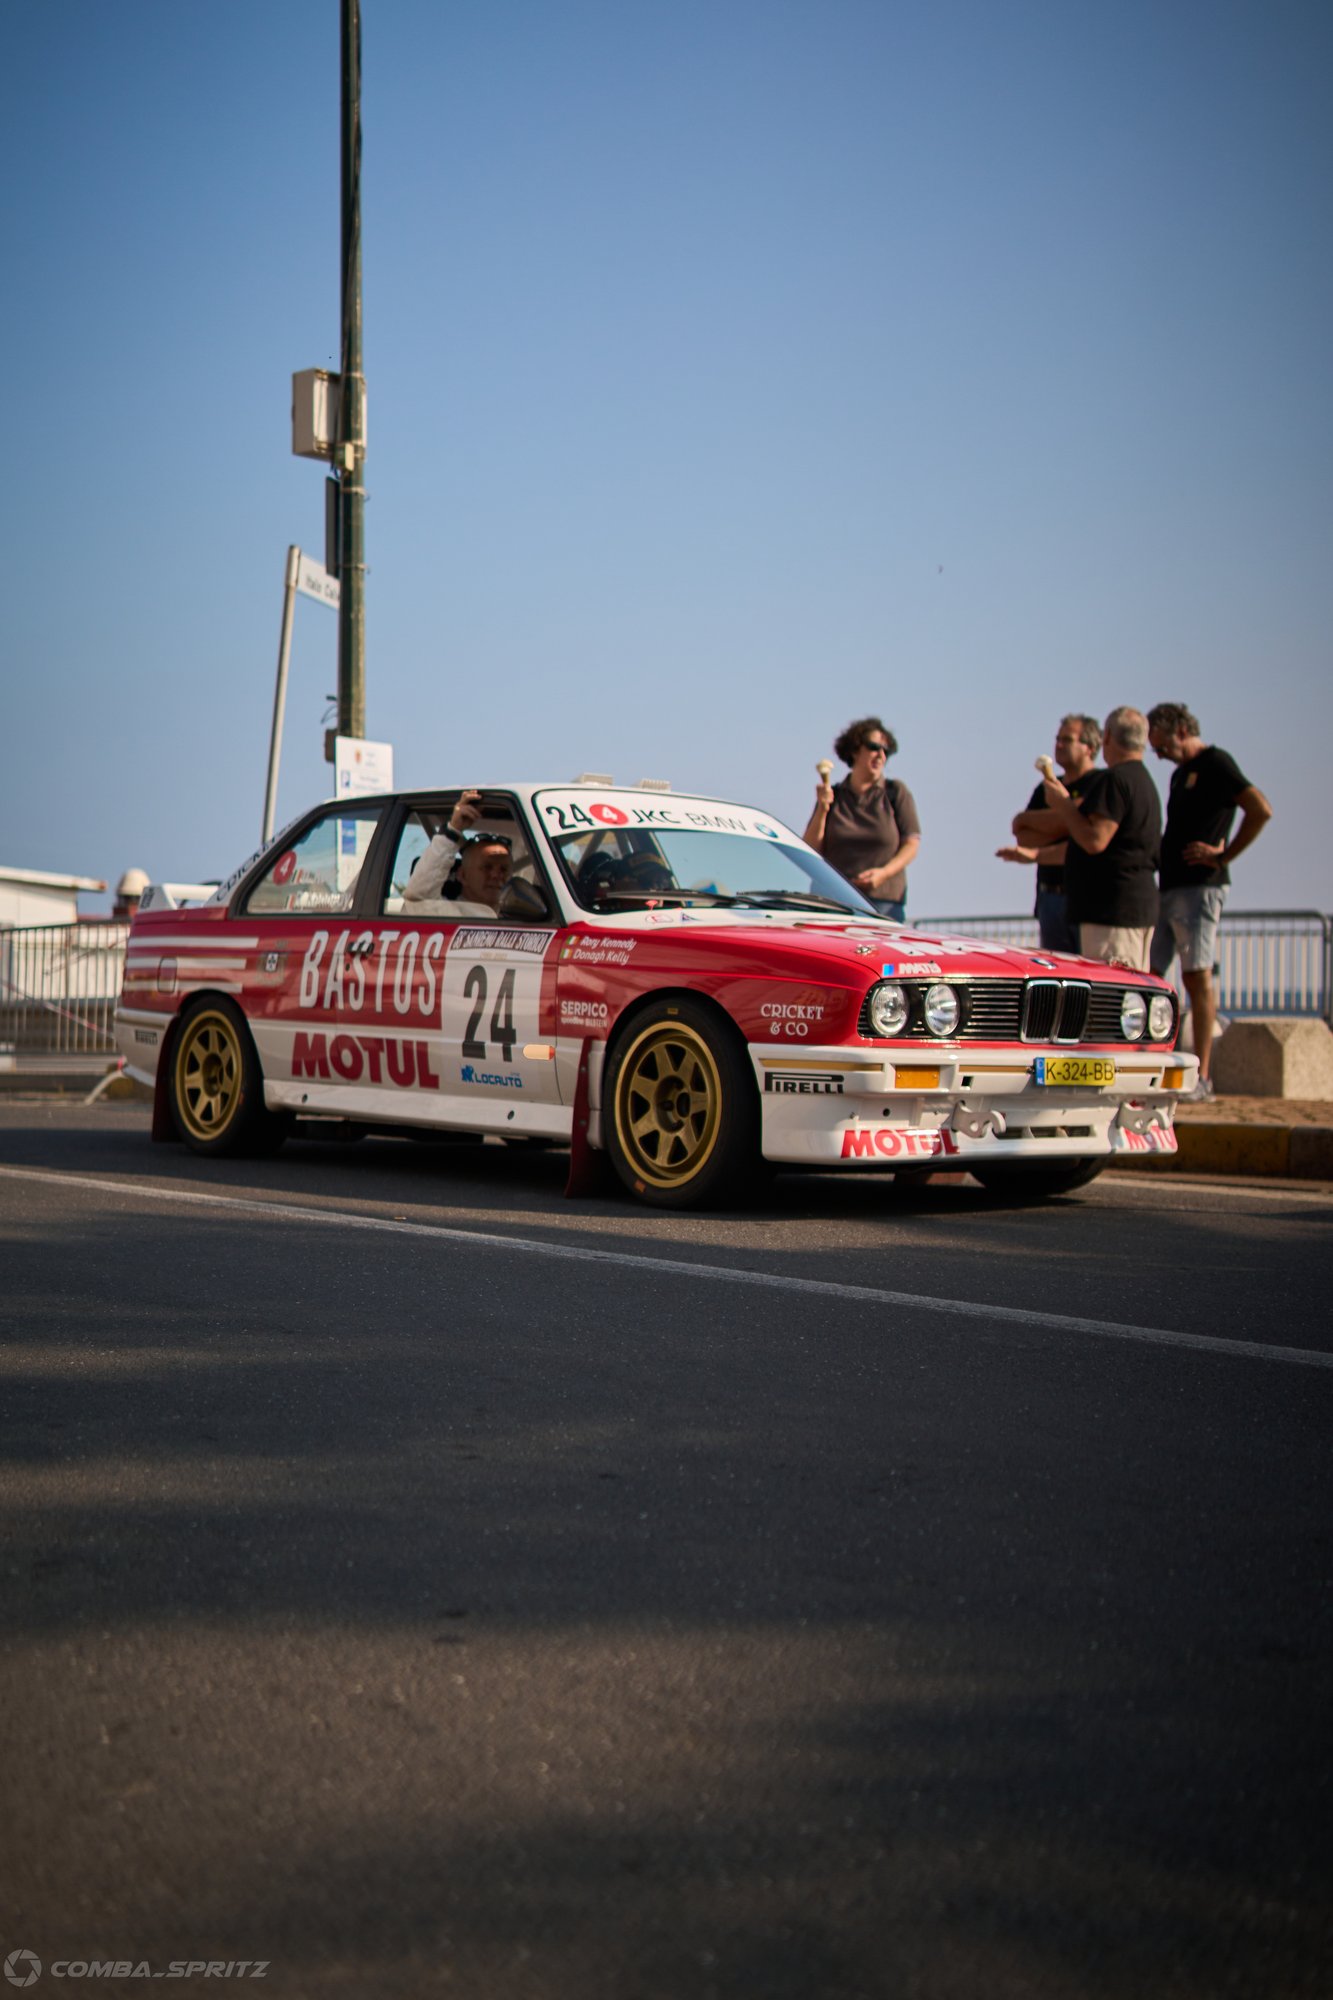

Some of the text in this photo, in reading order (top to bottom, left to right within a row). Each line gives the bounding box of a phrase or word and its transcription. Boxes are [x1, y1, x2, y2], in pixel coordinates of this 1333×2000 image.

[546, 803, 748, 832] 24 4 JKC BMW
[280, 857, 292, 876] 4
[580, 936, 637, 951] Rory Kennedy
[573, 949, 630, 966] Donagh Kelly
[299, 928, 445, 1017] BASTOS
[462, 965, 516, 1062] 24
[561, 1000, 608, 1018] SERPICO
[761, 1003, 824, 1020] CRICKET
[770, 1021, 808, 1036] & CO
[291, 1031, 440, 1090] MOTUL
[474, 1072, 523, 1088] LOCAUTO
[1046, 1062, 1114, 1081] K-324-BB
[765, 1072, 845, 1095] PIRELLI
[841, 1129, 960, 1159] MOTUL
